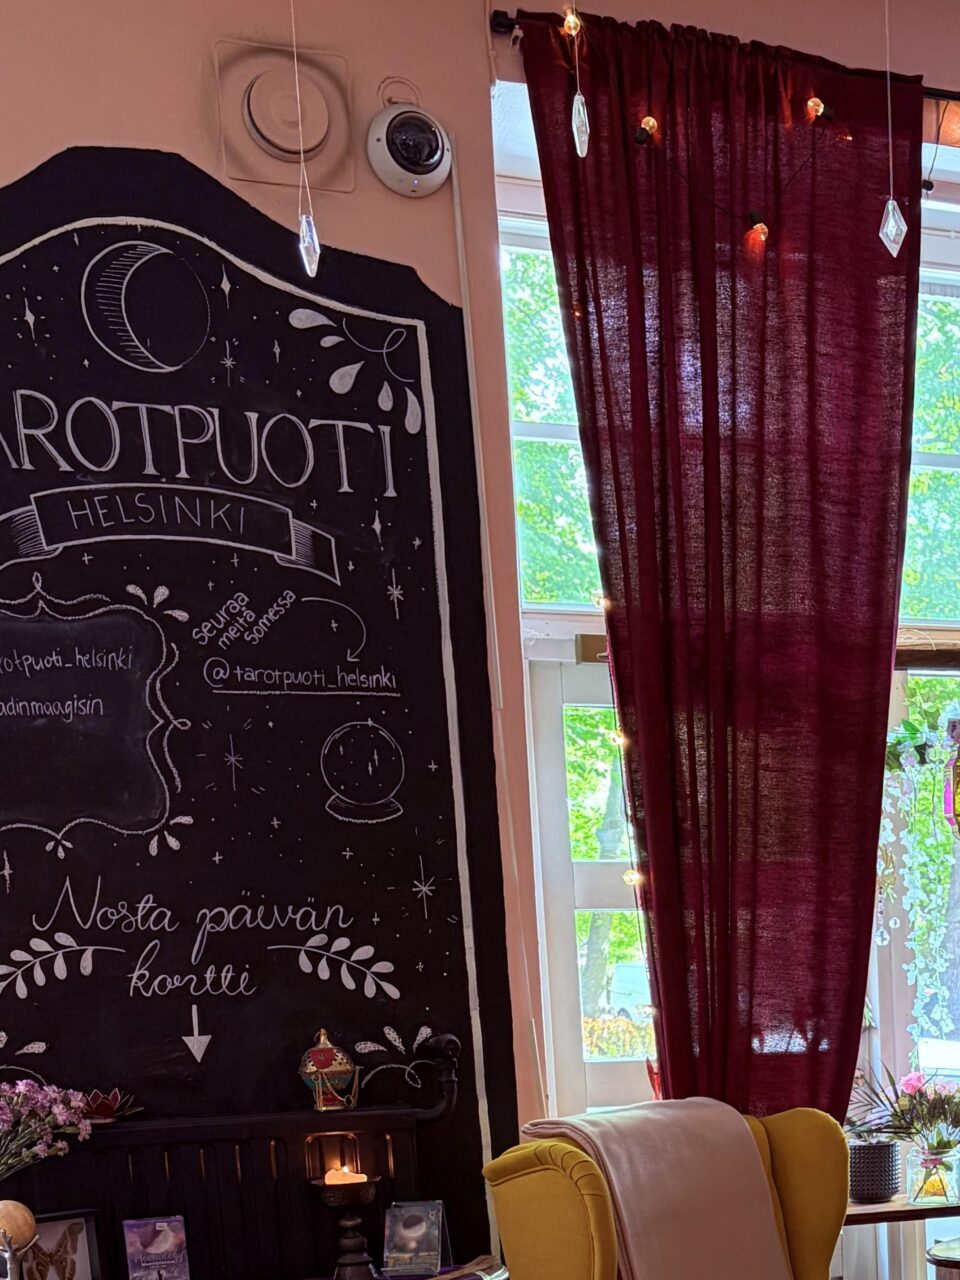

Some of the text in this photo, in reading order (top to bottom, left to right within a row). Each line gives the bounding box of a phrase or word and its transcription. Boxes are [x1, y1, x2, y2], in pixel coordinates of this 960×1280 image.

[0, 389, 398, 497] ROTPUOTI
[68, 493, 245, 535] HELSINKI
[33, 875, 355, 966] Nosta päivän
[129, 939, 258, 999] kortti
